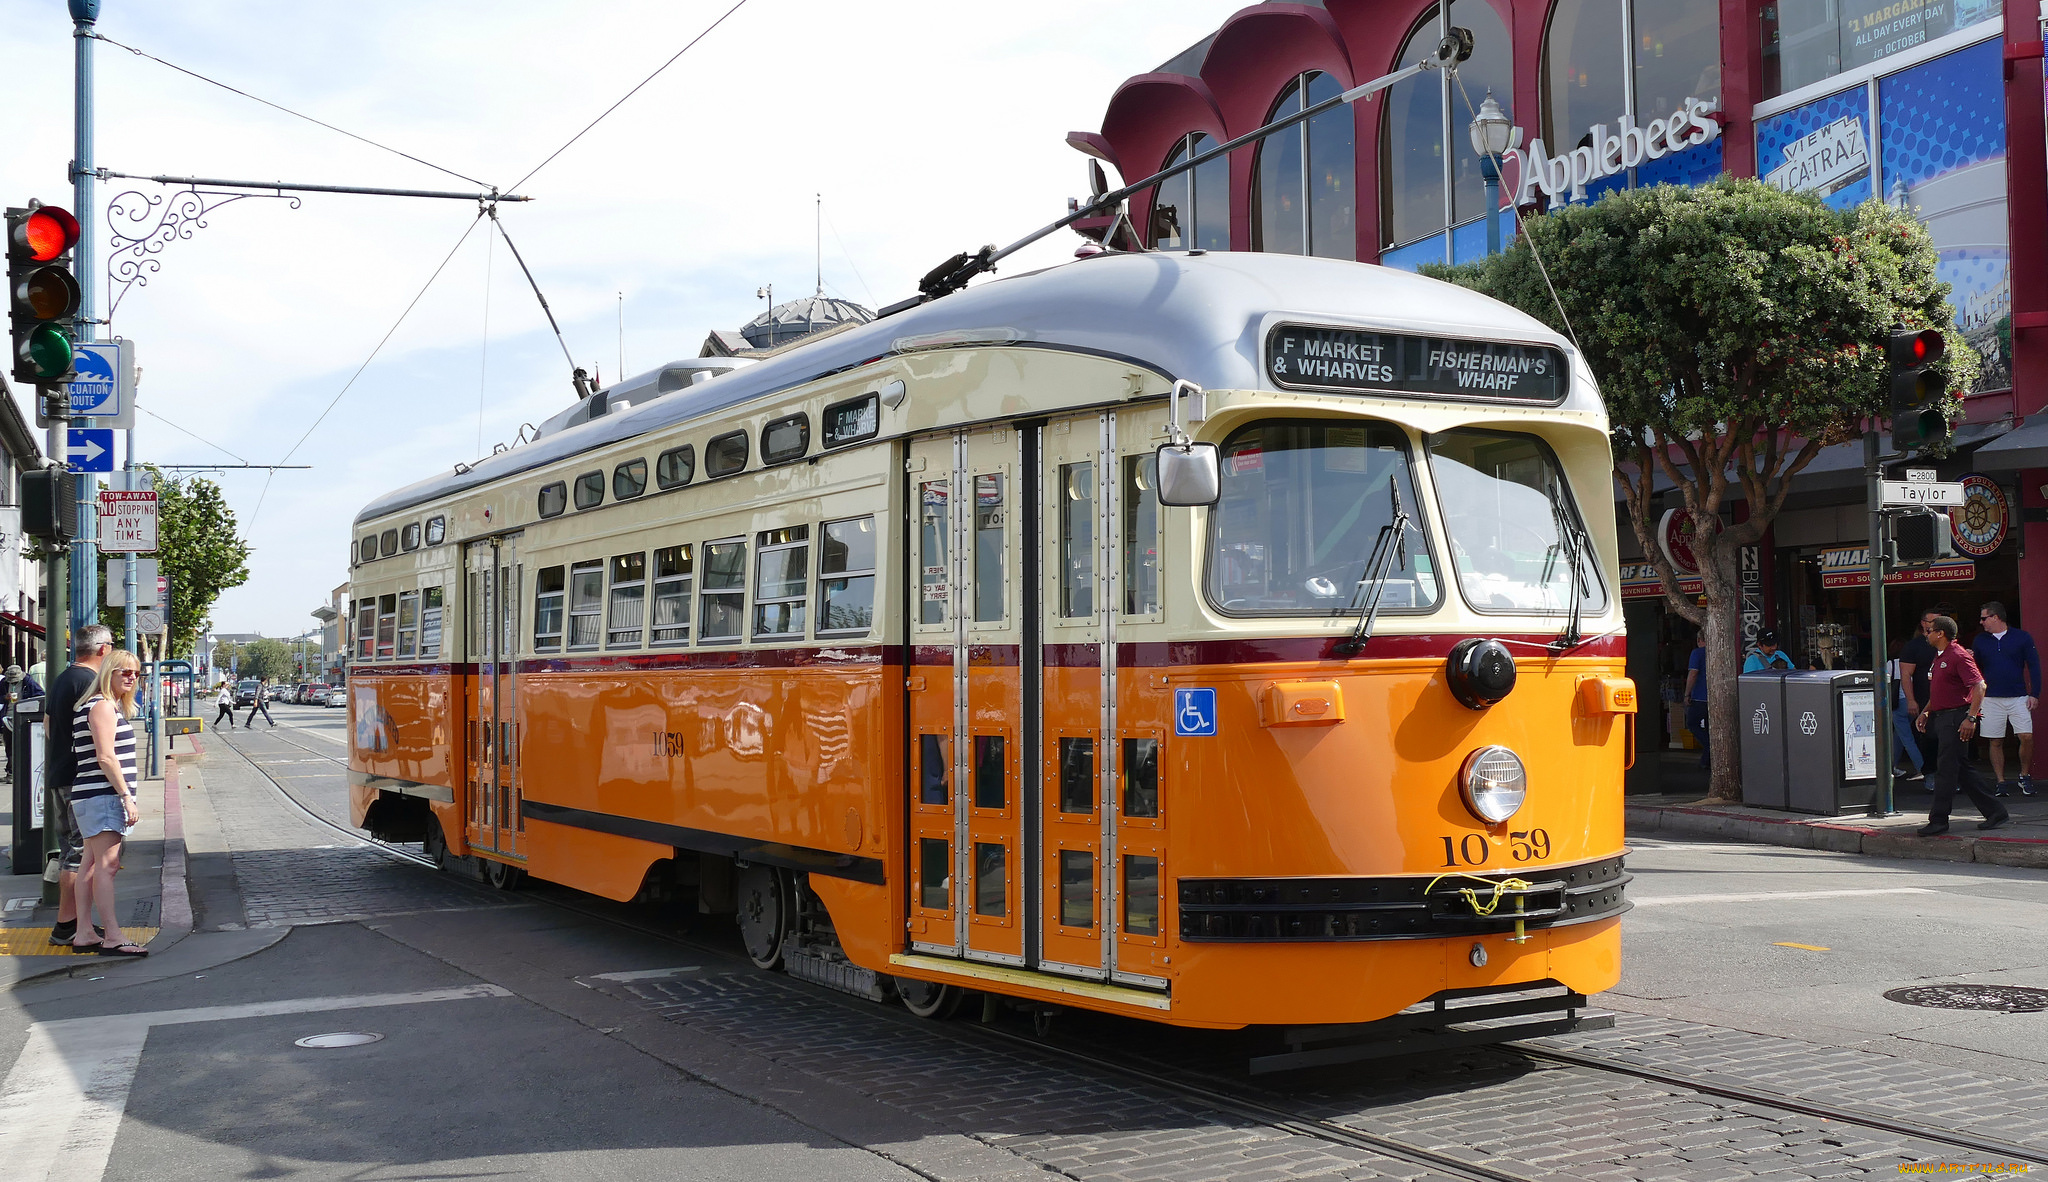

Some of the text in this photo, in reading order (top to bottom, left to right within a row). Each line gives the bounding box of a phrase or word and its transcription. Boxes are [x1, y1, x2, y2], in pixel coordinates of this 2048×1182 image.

[1855, 3, 1945, 47] ALL DAY EVERY DAY
[1873, 30, 1926, 59] in OCTOBER
[1785, 124, 1832, 159] VIEW
[1519, 96, 1718, 210] Applebee's
[1283, 337, 1384, 362] F MARKET
[1273, 356, 1393, 383] & WHARVES
[1428, 350, 1547, 375] FISHERMAN'S
[70, 383, 109, 395] CUATION
[1457, 370, 1519, 391] WHARF
[71, 395, 95, 406] OUTE
[837, 405, 876, 426] F MARKE
[834, 420, 876, 441] & WHARVE
[1916, 471, 1935, 481] 2800
[103, 492, 153, 500] TOW-AWAY
[1900, 486, 1947, 503] Taylor
[1964, 485, 1998, 505] HARF
[101, 501, 155, 515] NO STOPPING
[117, 518, 140, 528] ANY
[1958, 522, 2000, 543] CENTRAL
[114, 530, 142, 541] TIME
[1955, 534, 2003, 554] SPORTSWEAR
[1825, 576, 1848, 584] GIFTS
[1913, 569, 1971, 579] SPORTSWEAR
[1741, 571, 1761, 656] BILLABON
[652, 731, 684, 758] 1059
